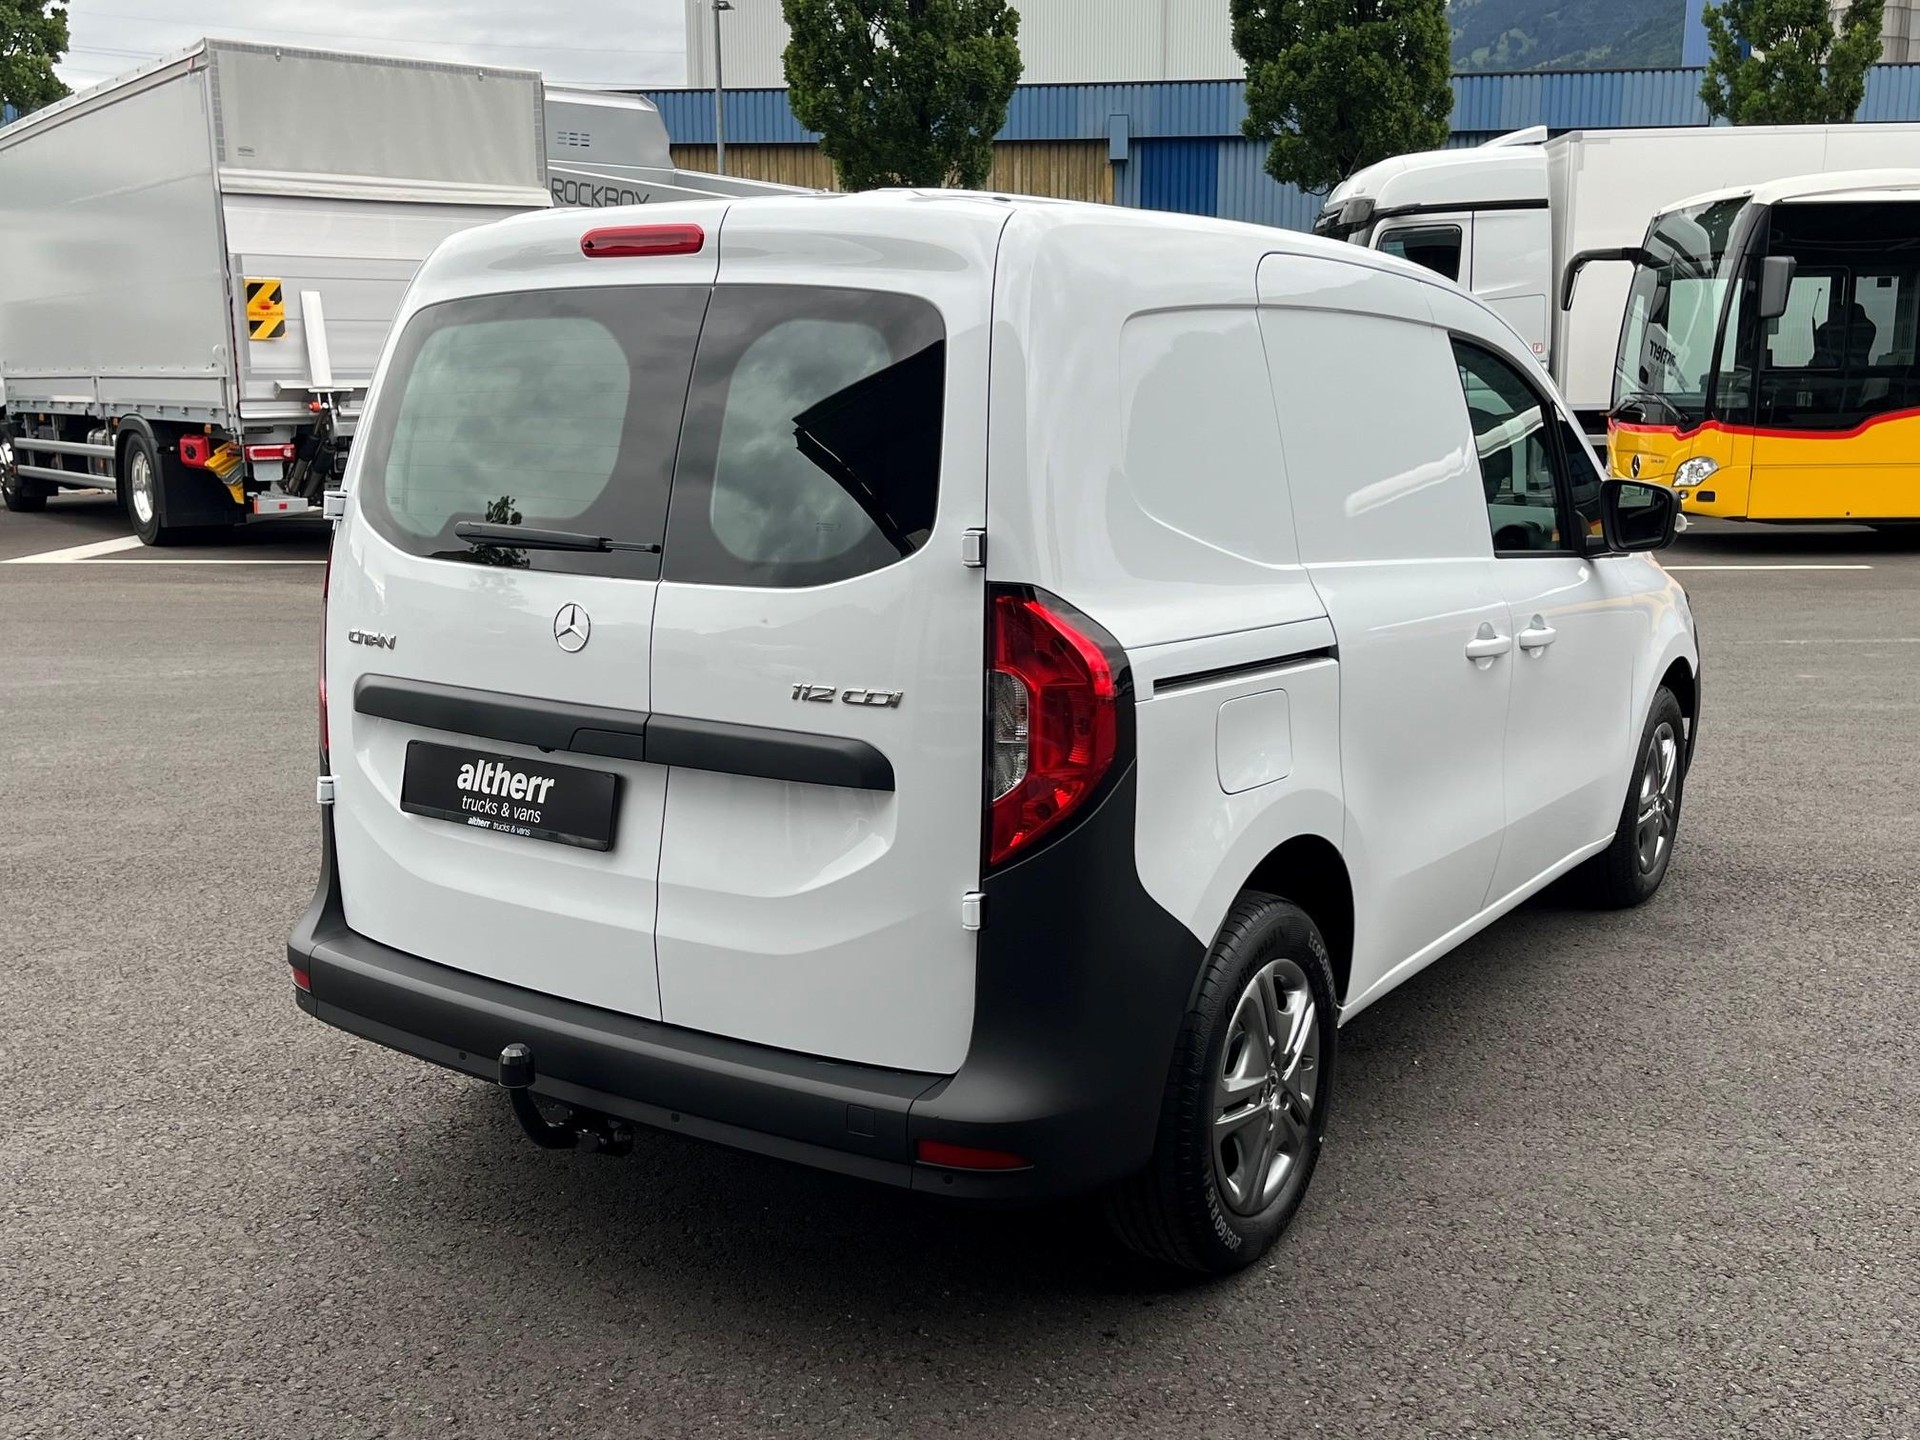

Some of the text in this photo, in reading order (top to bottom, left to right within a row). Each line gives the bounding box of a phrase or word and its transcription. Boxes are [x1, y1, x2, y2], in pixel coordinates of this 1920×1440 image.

[348, 629, 397, 651] CITAN
[791, 683, 904, 709] 112 CDI
[456, 759, 556, 804] altherr
[462, 795, 542, 824] trucks & vans
[467, 816, 531, 837] altherr trucks & vans
